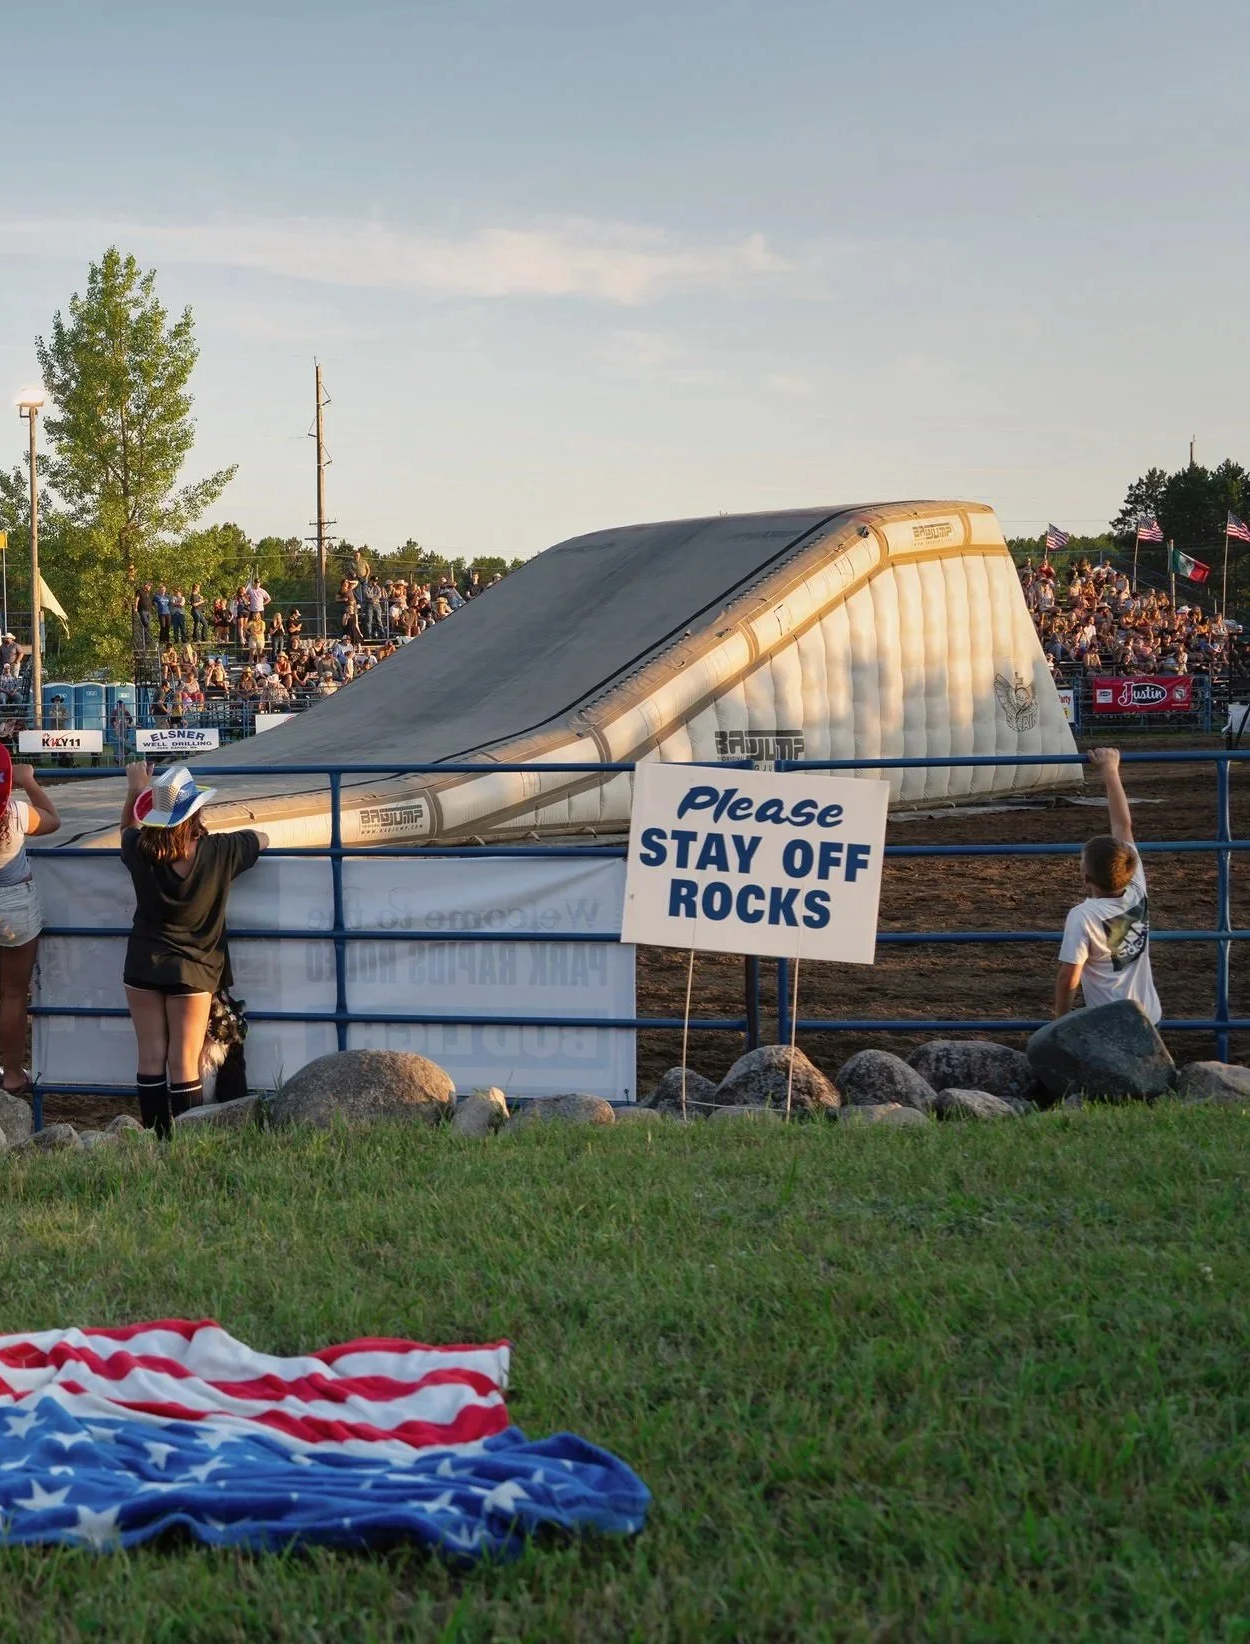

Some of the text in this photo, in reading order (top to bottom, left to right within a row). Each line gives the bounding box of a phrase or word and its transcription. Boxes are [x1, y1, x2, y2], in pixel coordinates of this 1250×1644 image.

[1117, 682, 1163, 706] Justin
[150, 730, 205, 742] ELSNER
[677, 784, 844, 828] Please
[639, 827, 871, 882] STAY OFF
[668, 878, 831, 929] ROCKS
